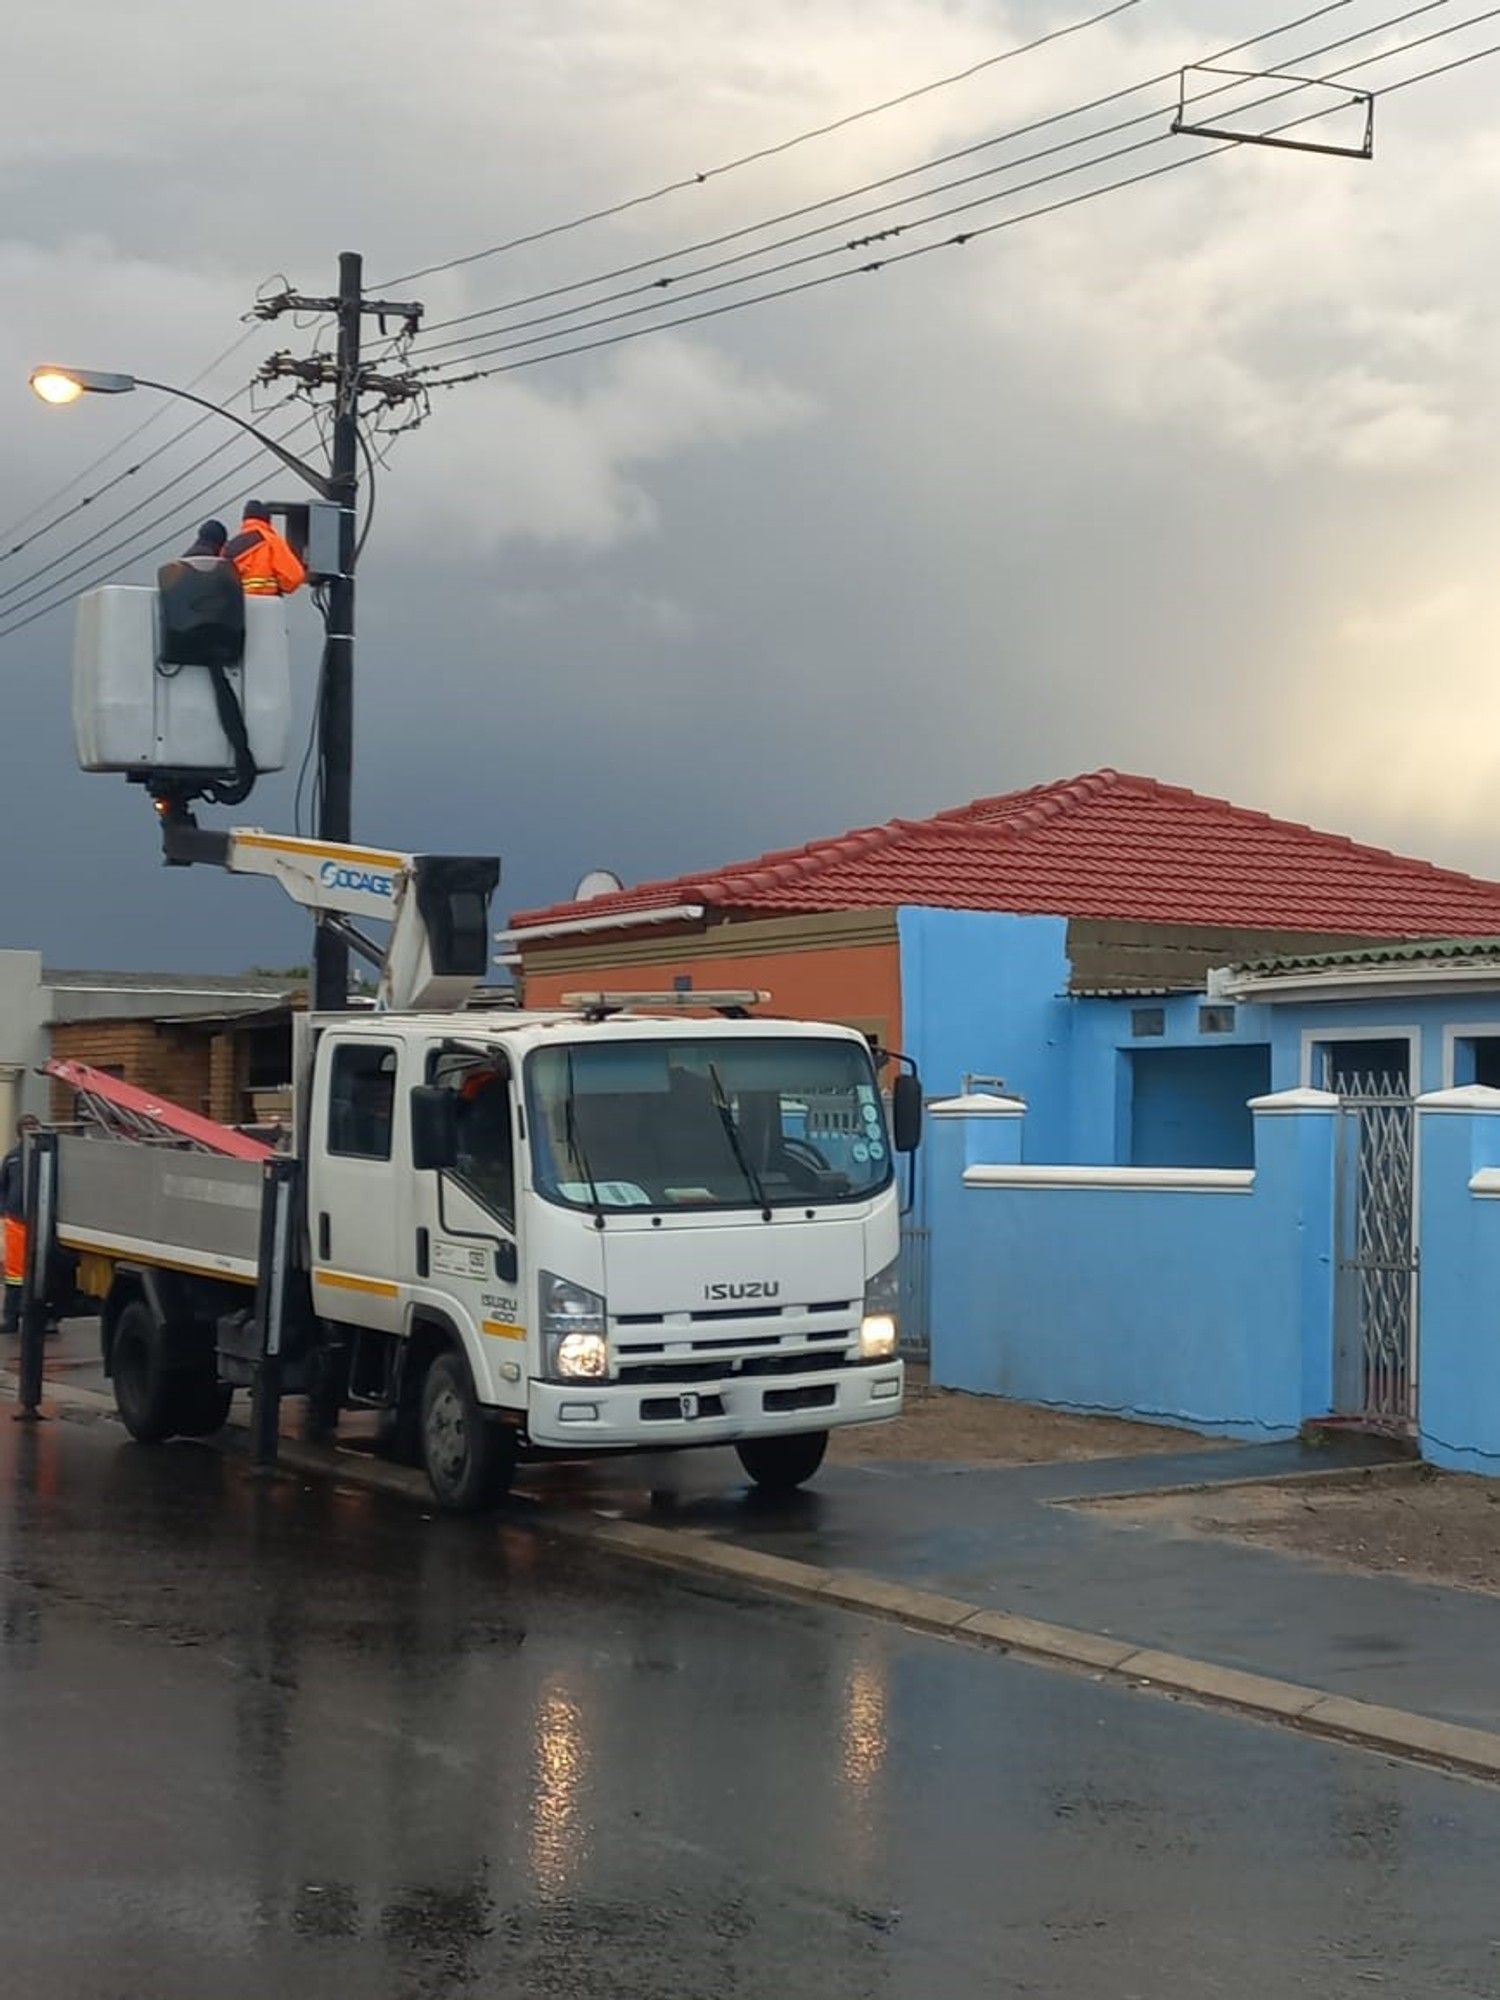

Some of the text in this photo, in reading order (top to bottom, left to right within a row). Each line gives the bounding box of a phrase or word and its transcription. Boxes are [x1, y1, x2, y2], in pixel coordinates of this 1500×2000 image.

[321, 862, 392, 897] SOCAGE
[705, 1282, 779, 1300] ISUZU
[481, 1294, 517, 1311] ISUZU
